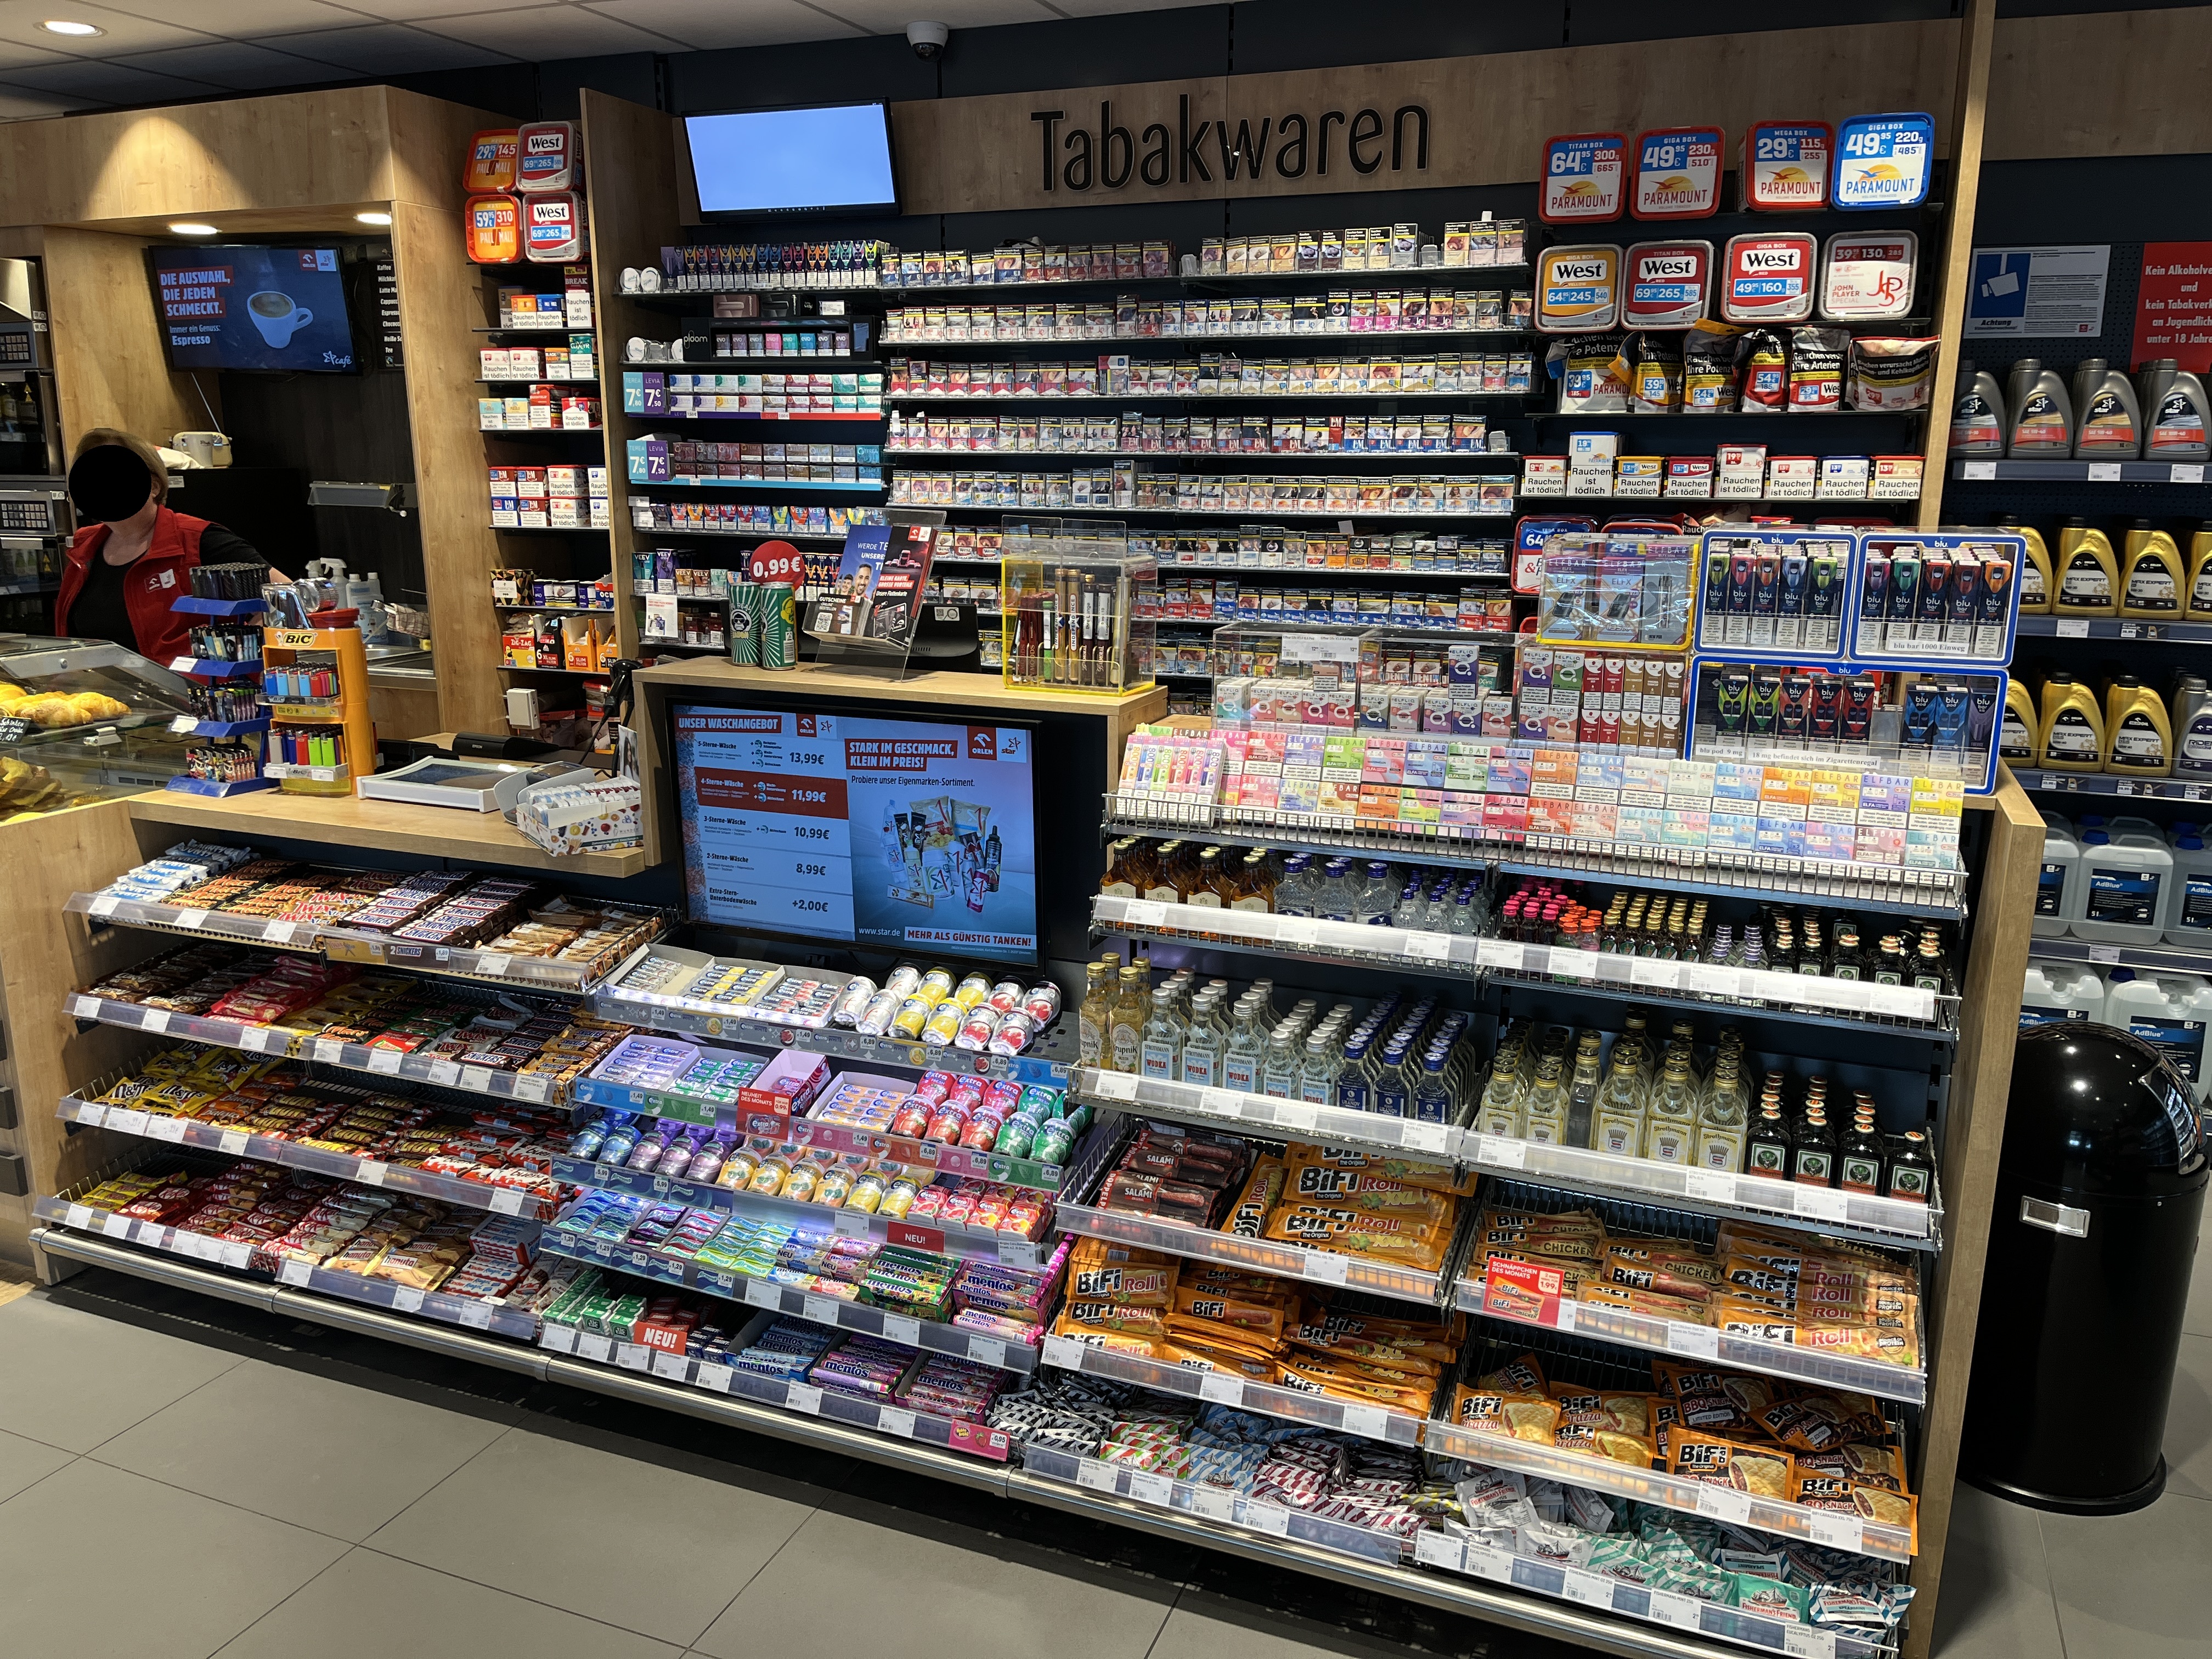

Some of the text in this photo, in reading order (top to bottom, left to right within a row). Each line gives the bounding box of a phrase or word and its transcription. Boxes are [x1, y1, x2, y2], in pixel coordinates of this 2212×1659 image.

[531, 137, 560, 149] West
[1031, 94, 1428, 191] Tabakwaren
[498, 144, 516, 155] 145
[1762, 182, 1821, 194] PARAMOUNT
[1847, 178, 1915, 194] PARAMOUNT
[1551, 194, 1612, 209] PARAMOUNT
[1644, 189, 1707, 205] PARAMOUNT
[496, 211, 513, 222] 310
[536, 206, 566, 218] West
[1746, 252, 1795, 267] West
[1557, 263, 1602, 278] West
[1645, 260, 1691, 275] West
[2146, 266, 2165, 275] Kein
[160, 270, 230, 286] DIE AUSWAHL,
[2181, 282, 2198, 292] und
[163, 287, 216, 301] DIE JEDEM
[167, 302, 222, 317] SCHMECKT.
[2145, 300, 2164, 309] kein
[172, 336, 210, 346] Espresso
[684, 331, 708, 349] ploom
[2147, 334, 2170, 343] unter
[2175, 334, 2186, 343] 18
[1584, 345, 1618, 355] Potenz
[335, 355, 352, 368] café
[1792, 362, 1840, 371] Ihre Arterien
[1687, 365, 1730, 374] Ihre Potenz
[1572, 468, 1611, 477] Rauchen
[1585, 477, 1596, 486] ist
[1621, 479, 1656, 488] Rauchen
[1671, 479, 1707, 489] Rauchen
[1723, 477, 1760, 486] Rauchen
[1575, 486, 1605, 495] tödlich
[1618, 487, 1660, 496] ist tödlich
[1668, 488, 1709, 496] ist tödlich
[1733, 485, 1762, 494] tödlich
[1940, 644, 1965, 652] Einweg
[679, 718, 778, 730] UNSER WASCHANGEBOT
[698, 741, 737, 749] 5-Sterne-Wäsche
[849, 742, 954, 757] STARK IM GESCHMACK,
[789, 752, 825, 765] 13,99€
[850, 756, 924, 768] KLEIN IM PREIS!
[1826, 757, 1877, 766] Zigarettenregal
[701, 778, 744, 788] 4-Sterne-Wäsche
[851, 776, 878, 784] Probiere
[898, 777, 975, 787] Eigenmarken-Sortiment.
[792, 789, 827, 803] 11,99€
[703, 816, 746, 826] 3-Sterne-Wäsche
[794, 827, 830, 840] 10,99€
[707, 853, 749, 863] 2-Sterne-Wäsche
[796, 864, 826, 876] 8,99€
[709, 888, 738, 896] Extra-Stern-
[710, 895, 757, 905] Unterbodenwäsche
[792, 900, 828, 912] +2,00€
[859, 927, 1031, 946] www.star.de MEHR ALS GÜNSTIG TANKEN!
[390, 946, 396, 955] 2
[1146, 1058, 1167, 1069] WODKA
[752, 1098, 772, 1106] MONATS
[1146, 1156, 1175, 1166] SALAMI
[1300, 1165, 1403, 1193] BiFi Roll
[1124, 1187, 1153, 1199] SALAMI
[1385, 1191, 1415, 1206] XXL
[905, 1233, 926, 1244] NEU!
[386, 1255, 414, 1268] hanuta
[1492, 1261, 1538, 1274] SCHNÄPPCHEN
[1504, 1268, 1531, 1279] MONATS
[1666, 1262, 1717, 1281] CHICKEN
[967, 1274, 1014, 1291] mentos
[1077, 1269, 1155, 1295] BiFi Roll
[1814, 1272, 1854, 1286] Roll
[644, 1328, 676, 1348] NEU!
[739, 1359, 785, 1374] mentos
[1692, 1413, 1712, 1422] LIMITED
[1742, 1602, 1776, 1616] FISHERMAN'S
